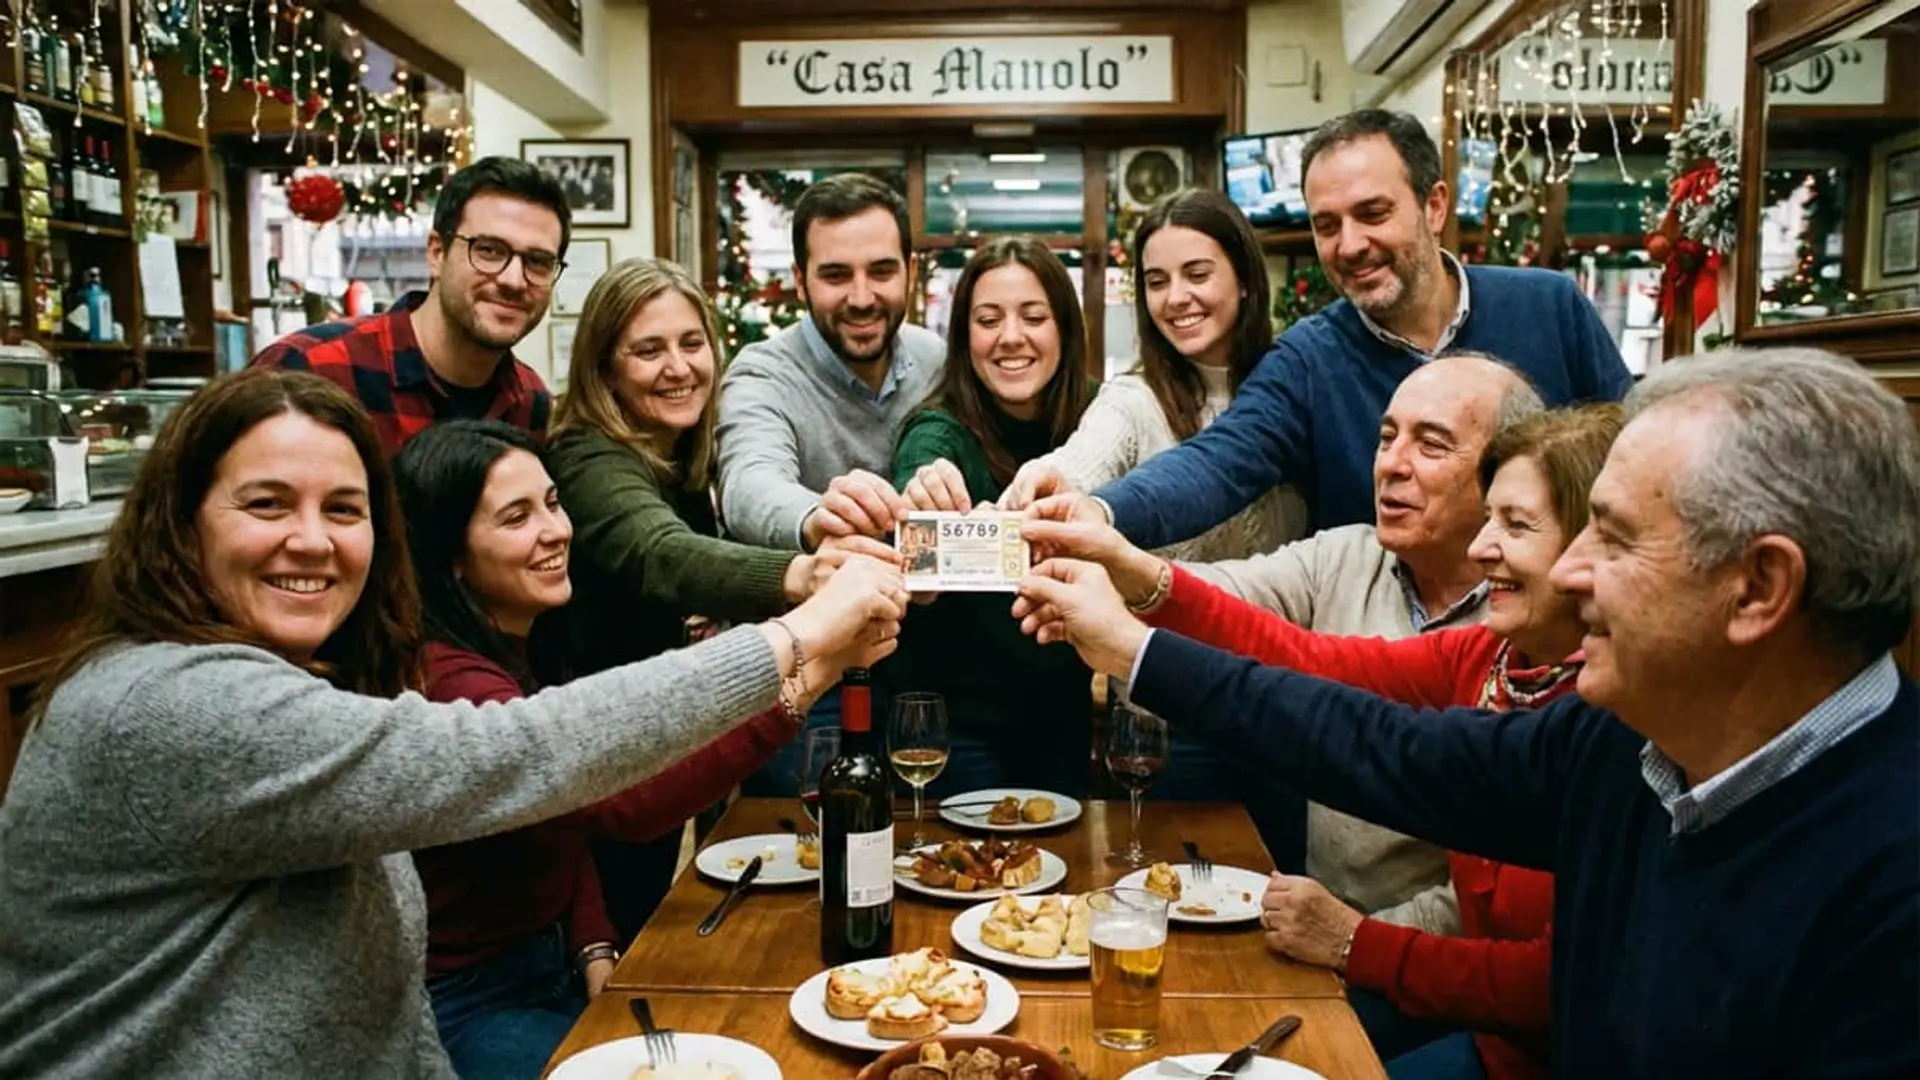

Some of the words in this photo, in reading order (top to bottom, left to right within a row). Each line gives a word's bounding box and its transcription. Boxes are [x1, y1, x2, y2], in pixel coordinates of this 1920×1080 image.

[766, 50, 912, 95] “Casa
[931, 45, 1149, 95] Manolo”
[942, 523, 999, 537] 56789
